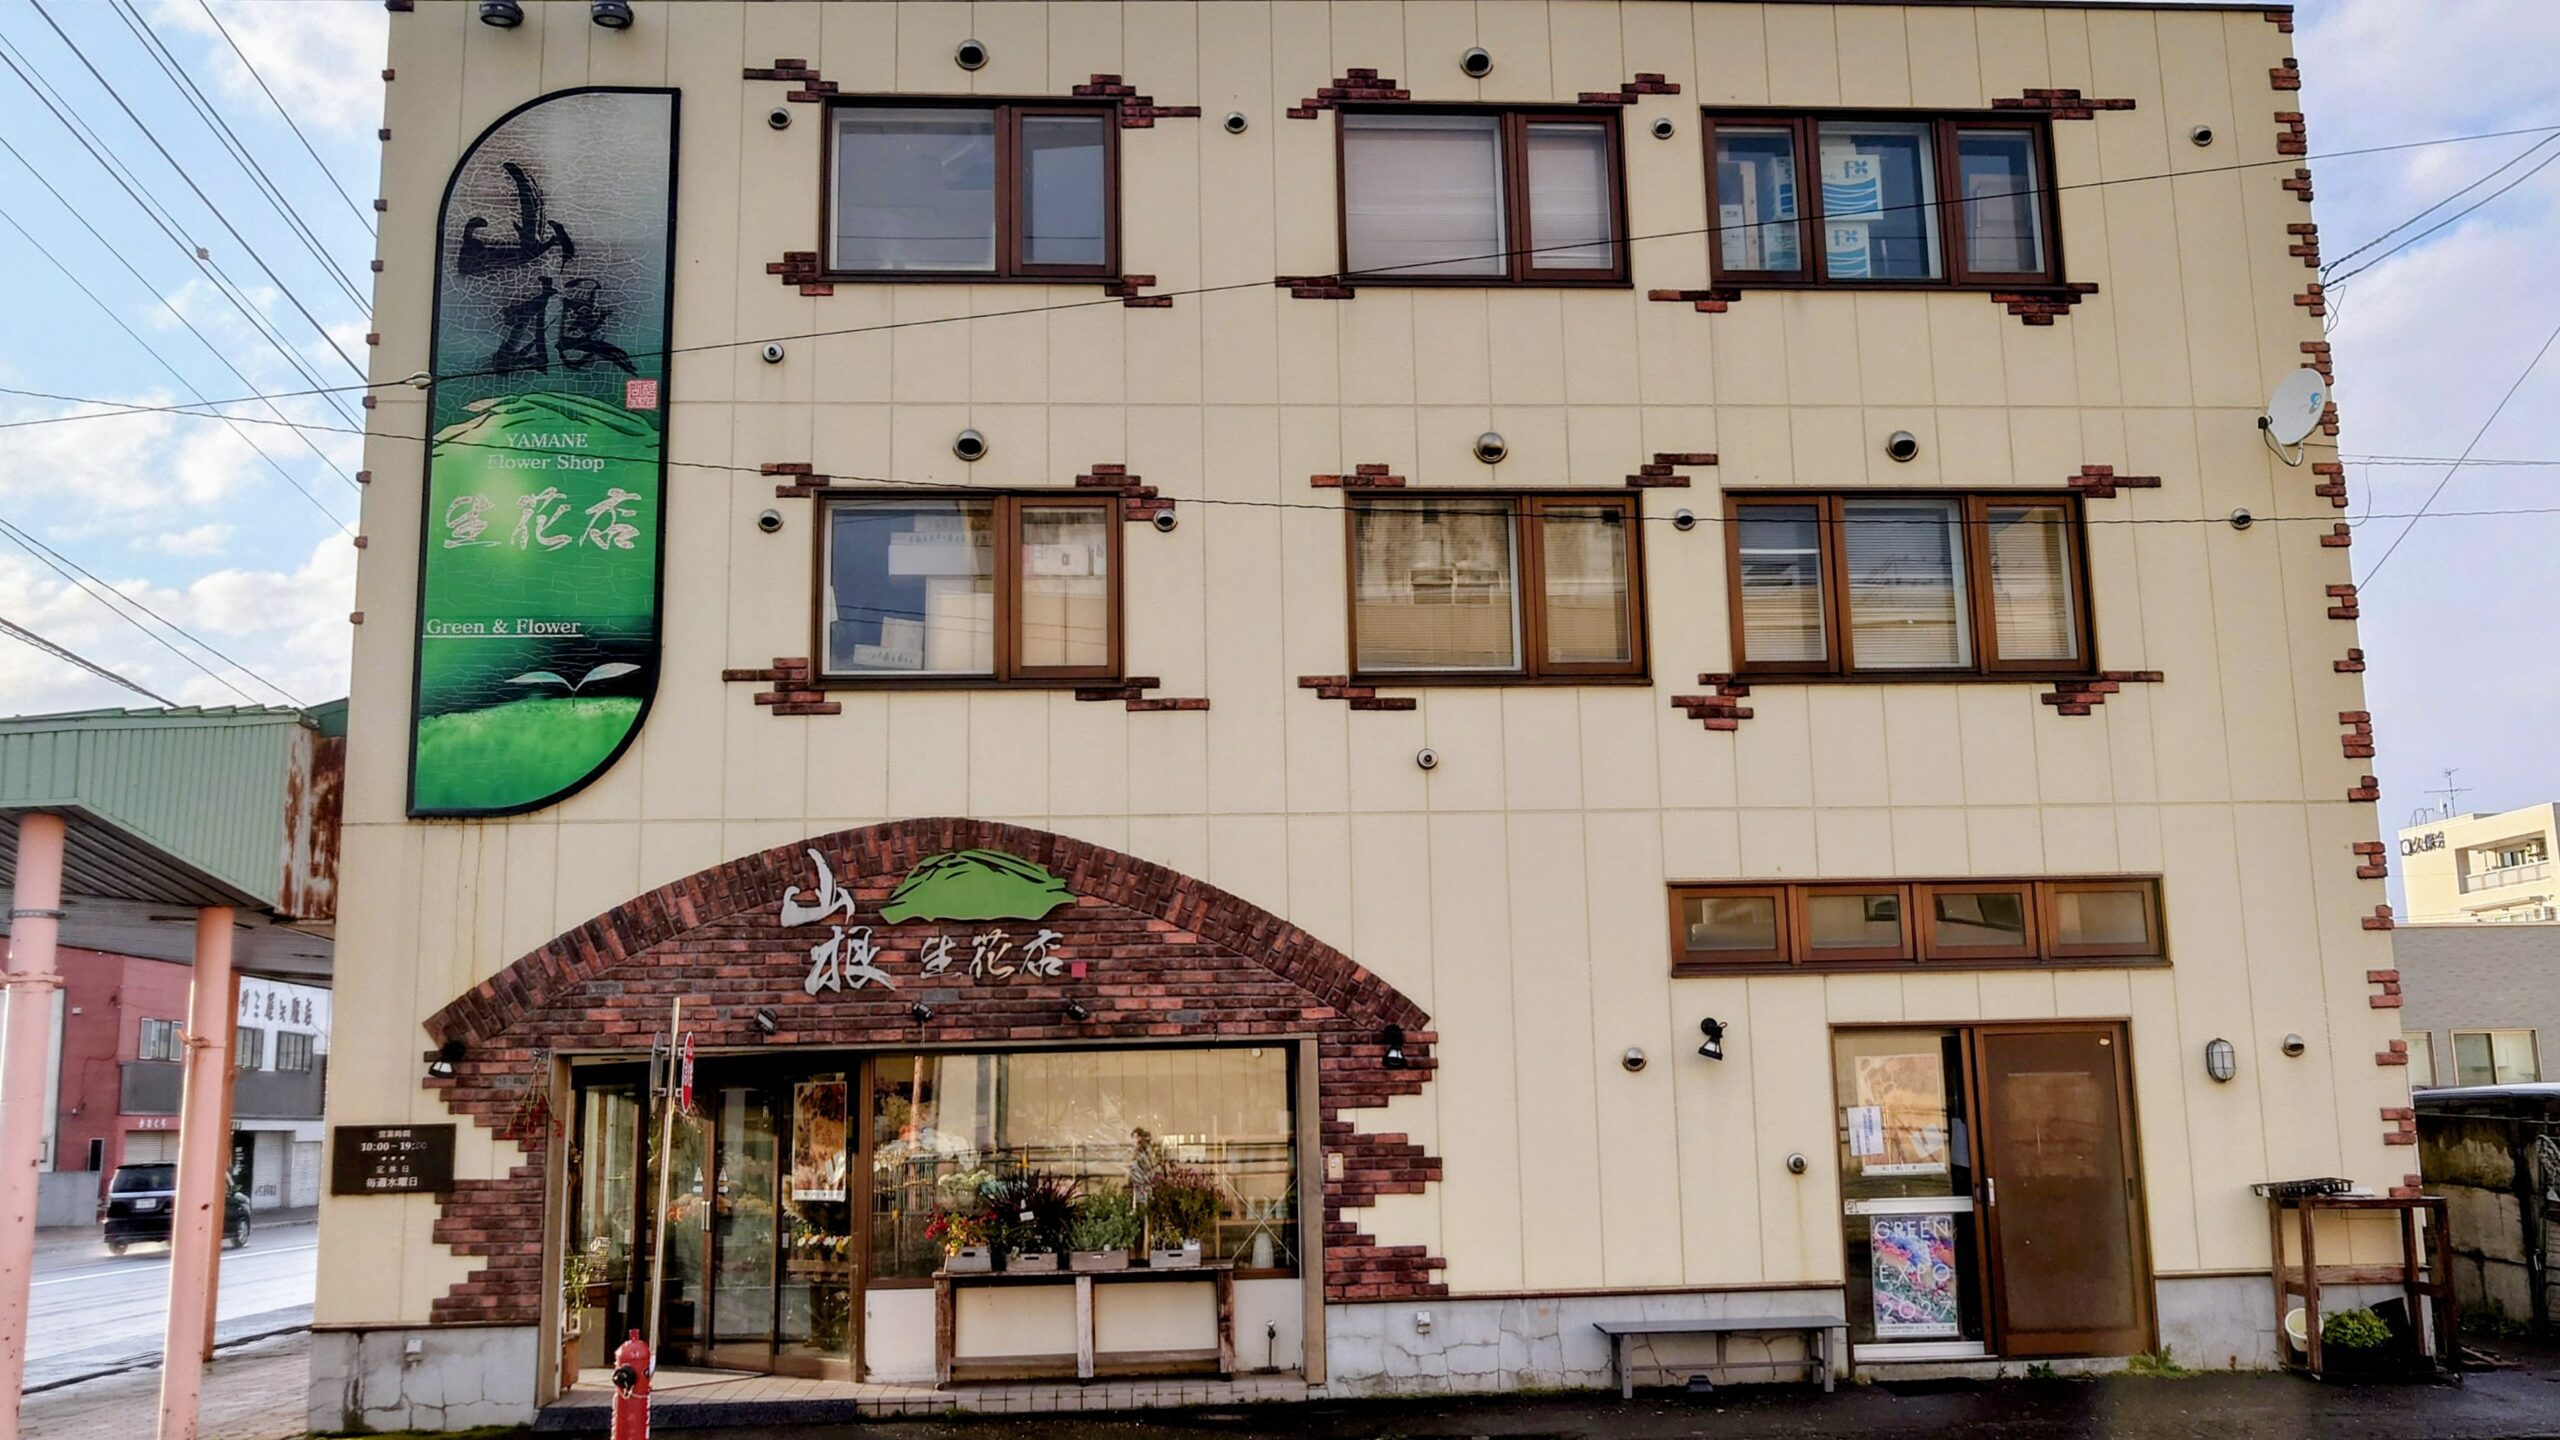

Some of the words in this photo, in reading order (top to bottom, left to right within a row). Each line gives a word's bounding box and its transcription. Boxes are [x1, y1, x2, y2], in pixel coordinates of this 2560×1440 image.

[505, 432, 588, 449] YAMANE
[487, 454, 552, 470] Flower
[556, 454, 605, 473] Shop
[443, 486, 643, 551] 生花店
[426, 619, 486, 634] Green
[492, 618, 510, 634] &
[515, 618, 581, 634] Flower
[919, 928, 1065, 980] 生花店
[366, 1177, 418, 1187] 毎週水曜日
[1874, 1220, 1949, 1239] GREEN
[1880, 1264, 1950, 1284] EXPO
[1882, 1301, 1952, 1319] 2027
